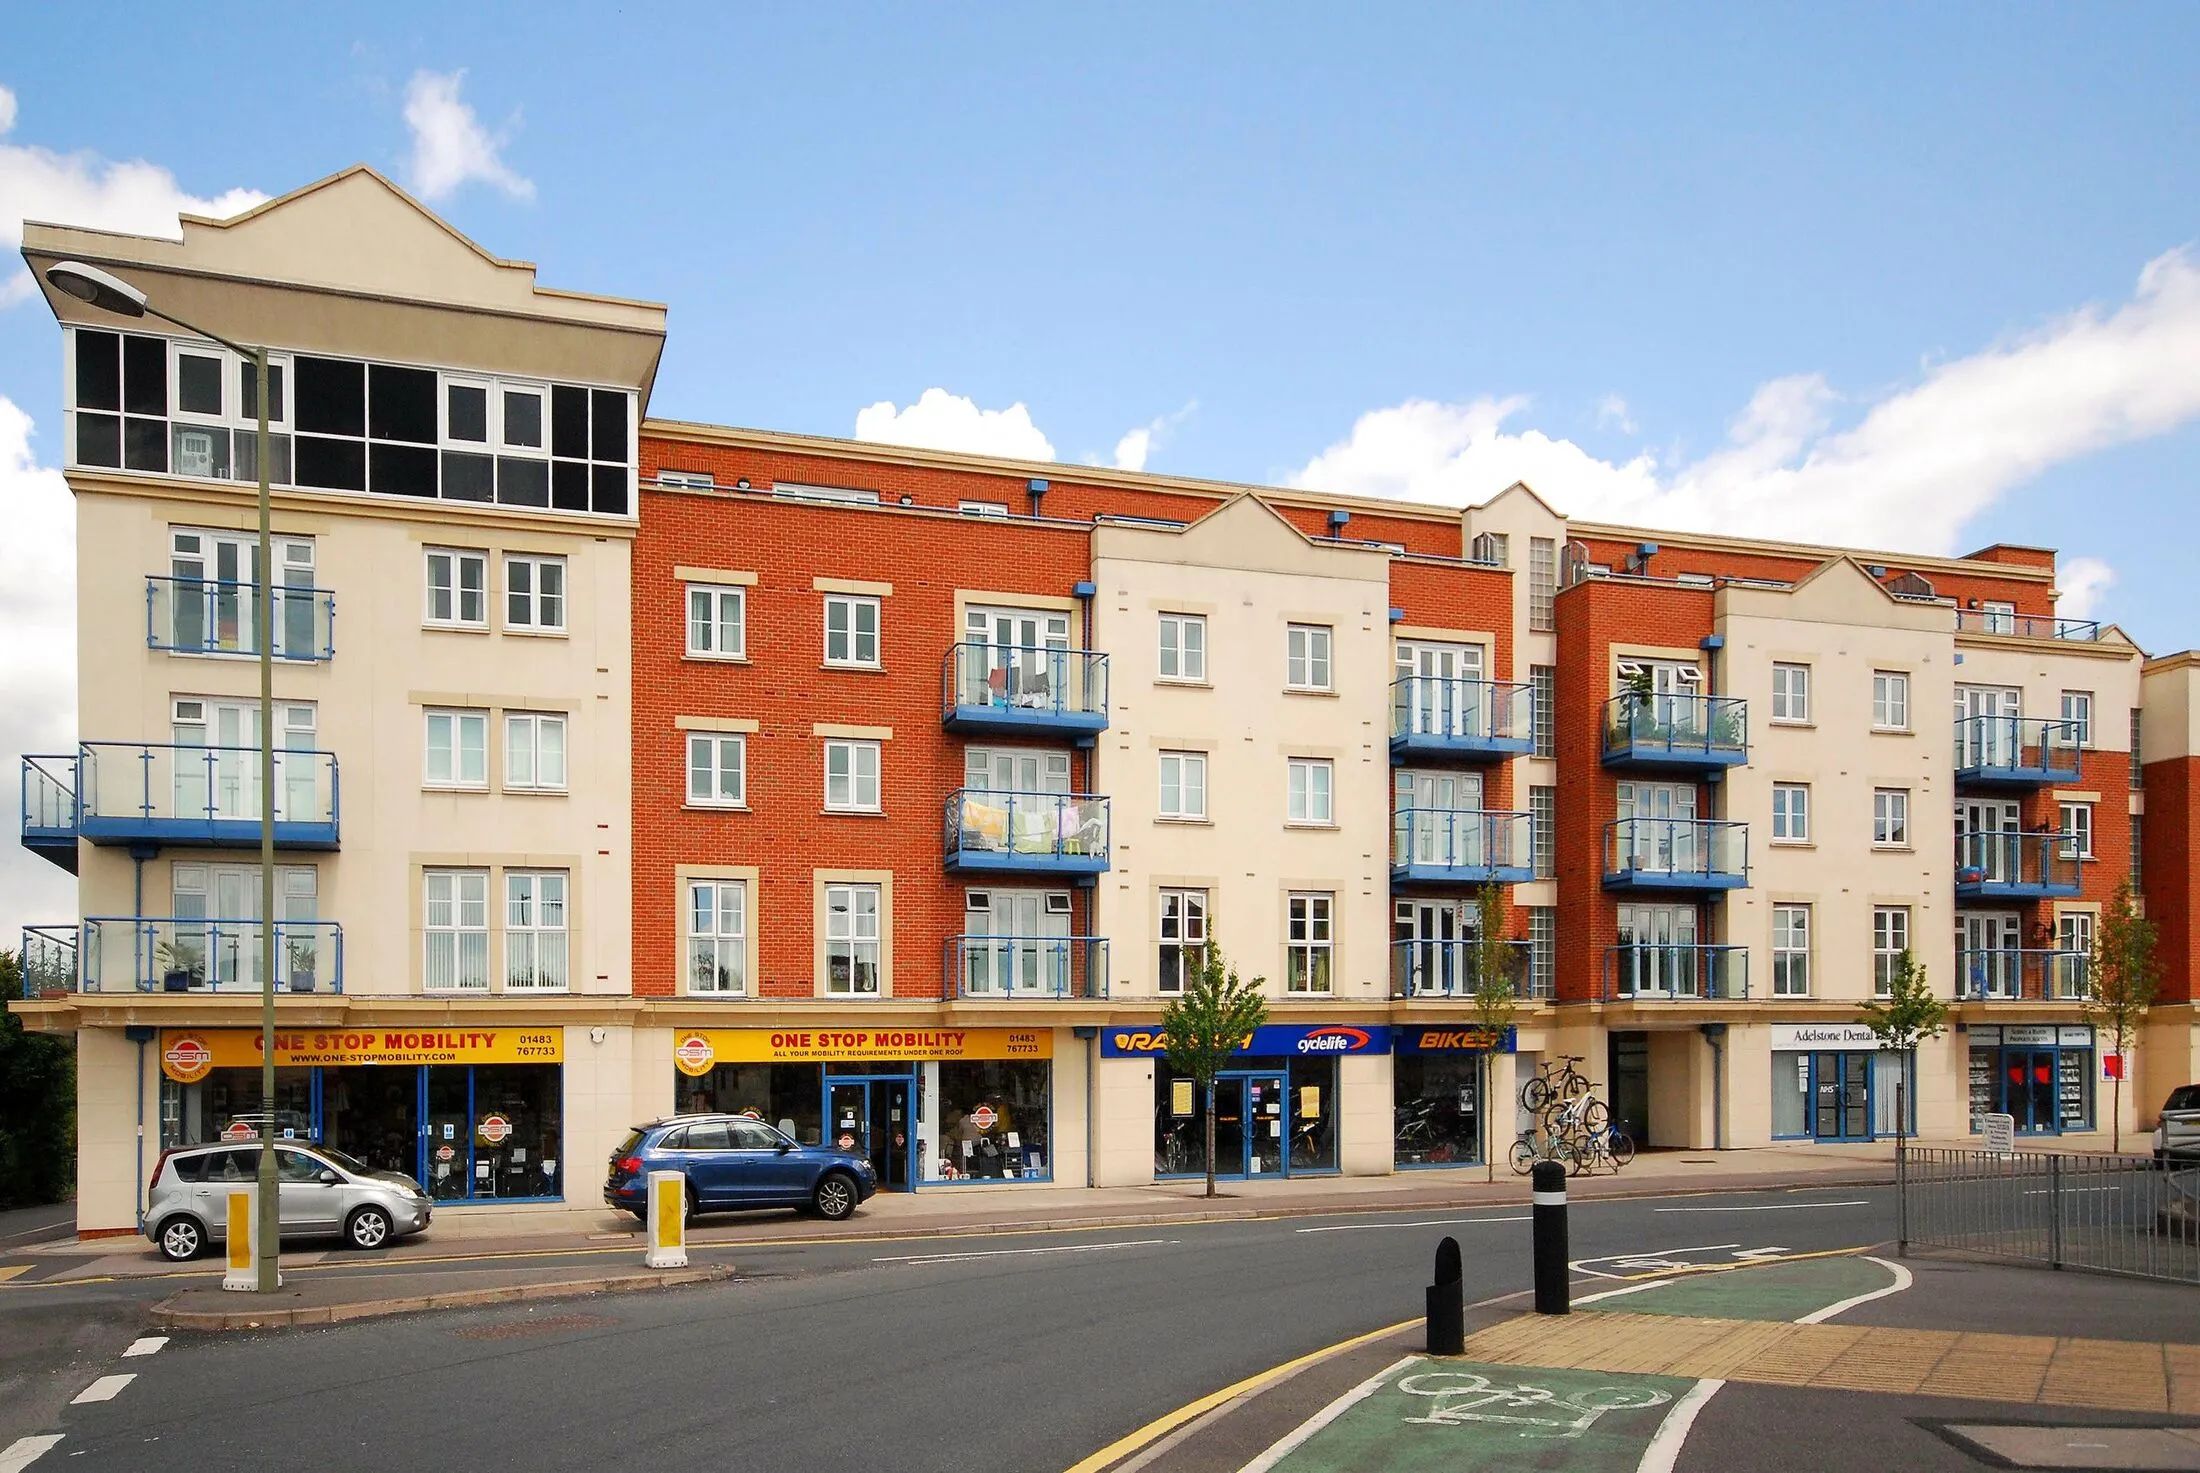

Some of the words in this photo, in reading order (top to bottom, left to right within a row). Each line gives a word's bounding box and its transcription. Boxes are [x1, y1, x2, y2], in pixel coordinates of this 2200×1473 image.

[519, 1035, 552, 1044] 01483
[1009, 1034, 1036, 1042] 01483
[1794, 1029, 1841, 1041] Adelstone
[1843, 1029, 1873, 1041] Dental
[254, 1034, 305, 1050] ONE
[314, 1034, 376, 1050] STOP
[384, 1033, 496, 1050] MOBILITY
[770, 1033, 811, 1048] ONE
[818, 1033, 868, 1047] STOP
[875, 1033, 965, 1047] MOBILITY
[1298, 1035, 1348, 1053] cyclelife
[516, 1047, 555, 1055] 767733
[1007, 1044, 1039, 1053] 767733
[1819, 1085, 1835, 1093] NHS
